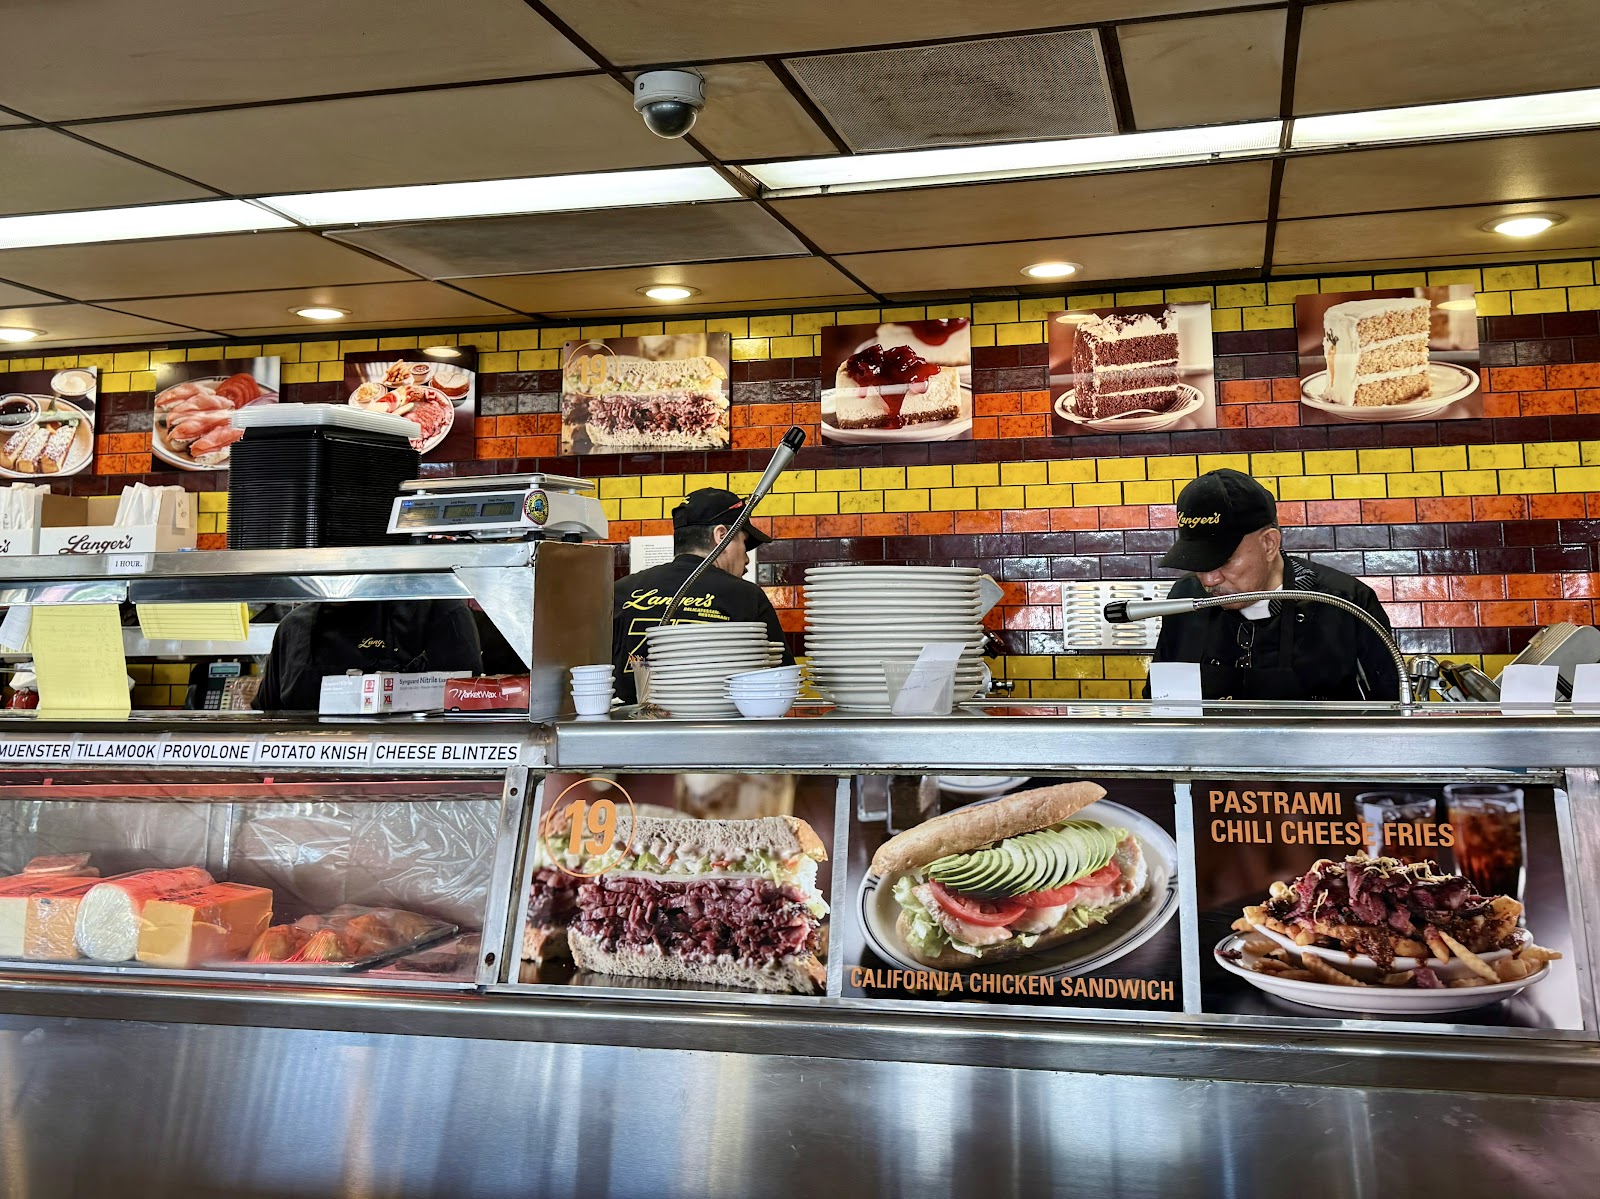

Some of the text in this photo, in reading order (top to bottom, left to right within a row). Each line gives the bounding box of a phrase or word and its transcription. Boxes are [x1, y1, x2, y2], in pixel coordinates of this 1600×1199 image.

[577, 353, 607, 385] 19
[1177, 511, 1221, 528] Langer's
[58, 534, 133, 554] Langer's
[119, 560, 143, 568] HOUR.
[623, 588, 715, 611] Laner's
[420, 676, 438, 684] Nitrile
[384, 695, 393, 704] XL
[0, 744, 71, 758] MUENSTER
[77, 743, 157, 758] TILLAMOOK
[163, 744, 250, 759] PROVOLONE
[260, 744, 368, 760] POTATO KNISH
[376, 745, 518, 761] CHEESE BLINTZES
[1208, 790, 1342, 815] PASTRAMI
[564, 798, 617, 856] 19
[1210, 819, 1456, 848] CHILI CHEESE FRIES
[849, 967, 1175, 1001] CALIFORNIA CHICKEN SANDWICH
